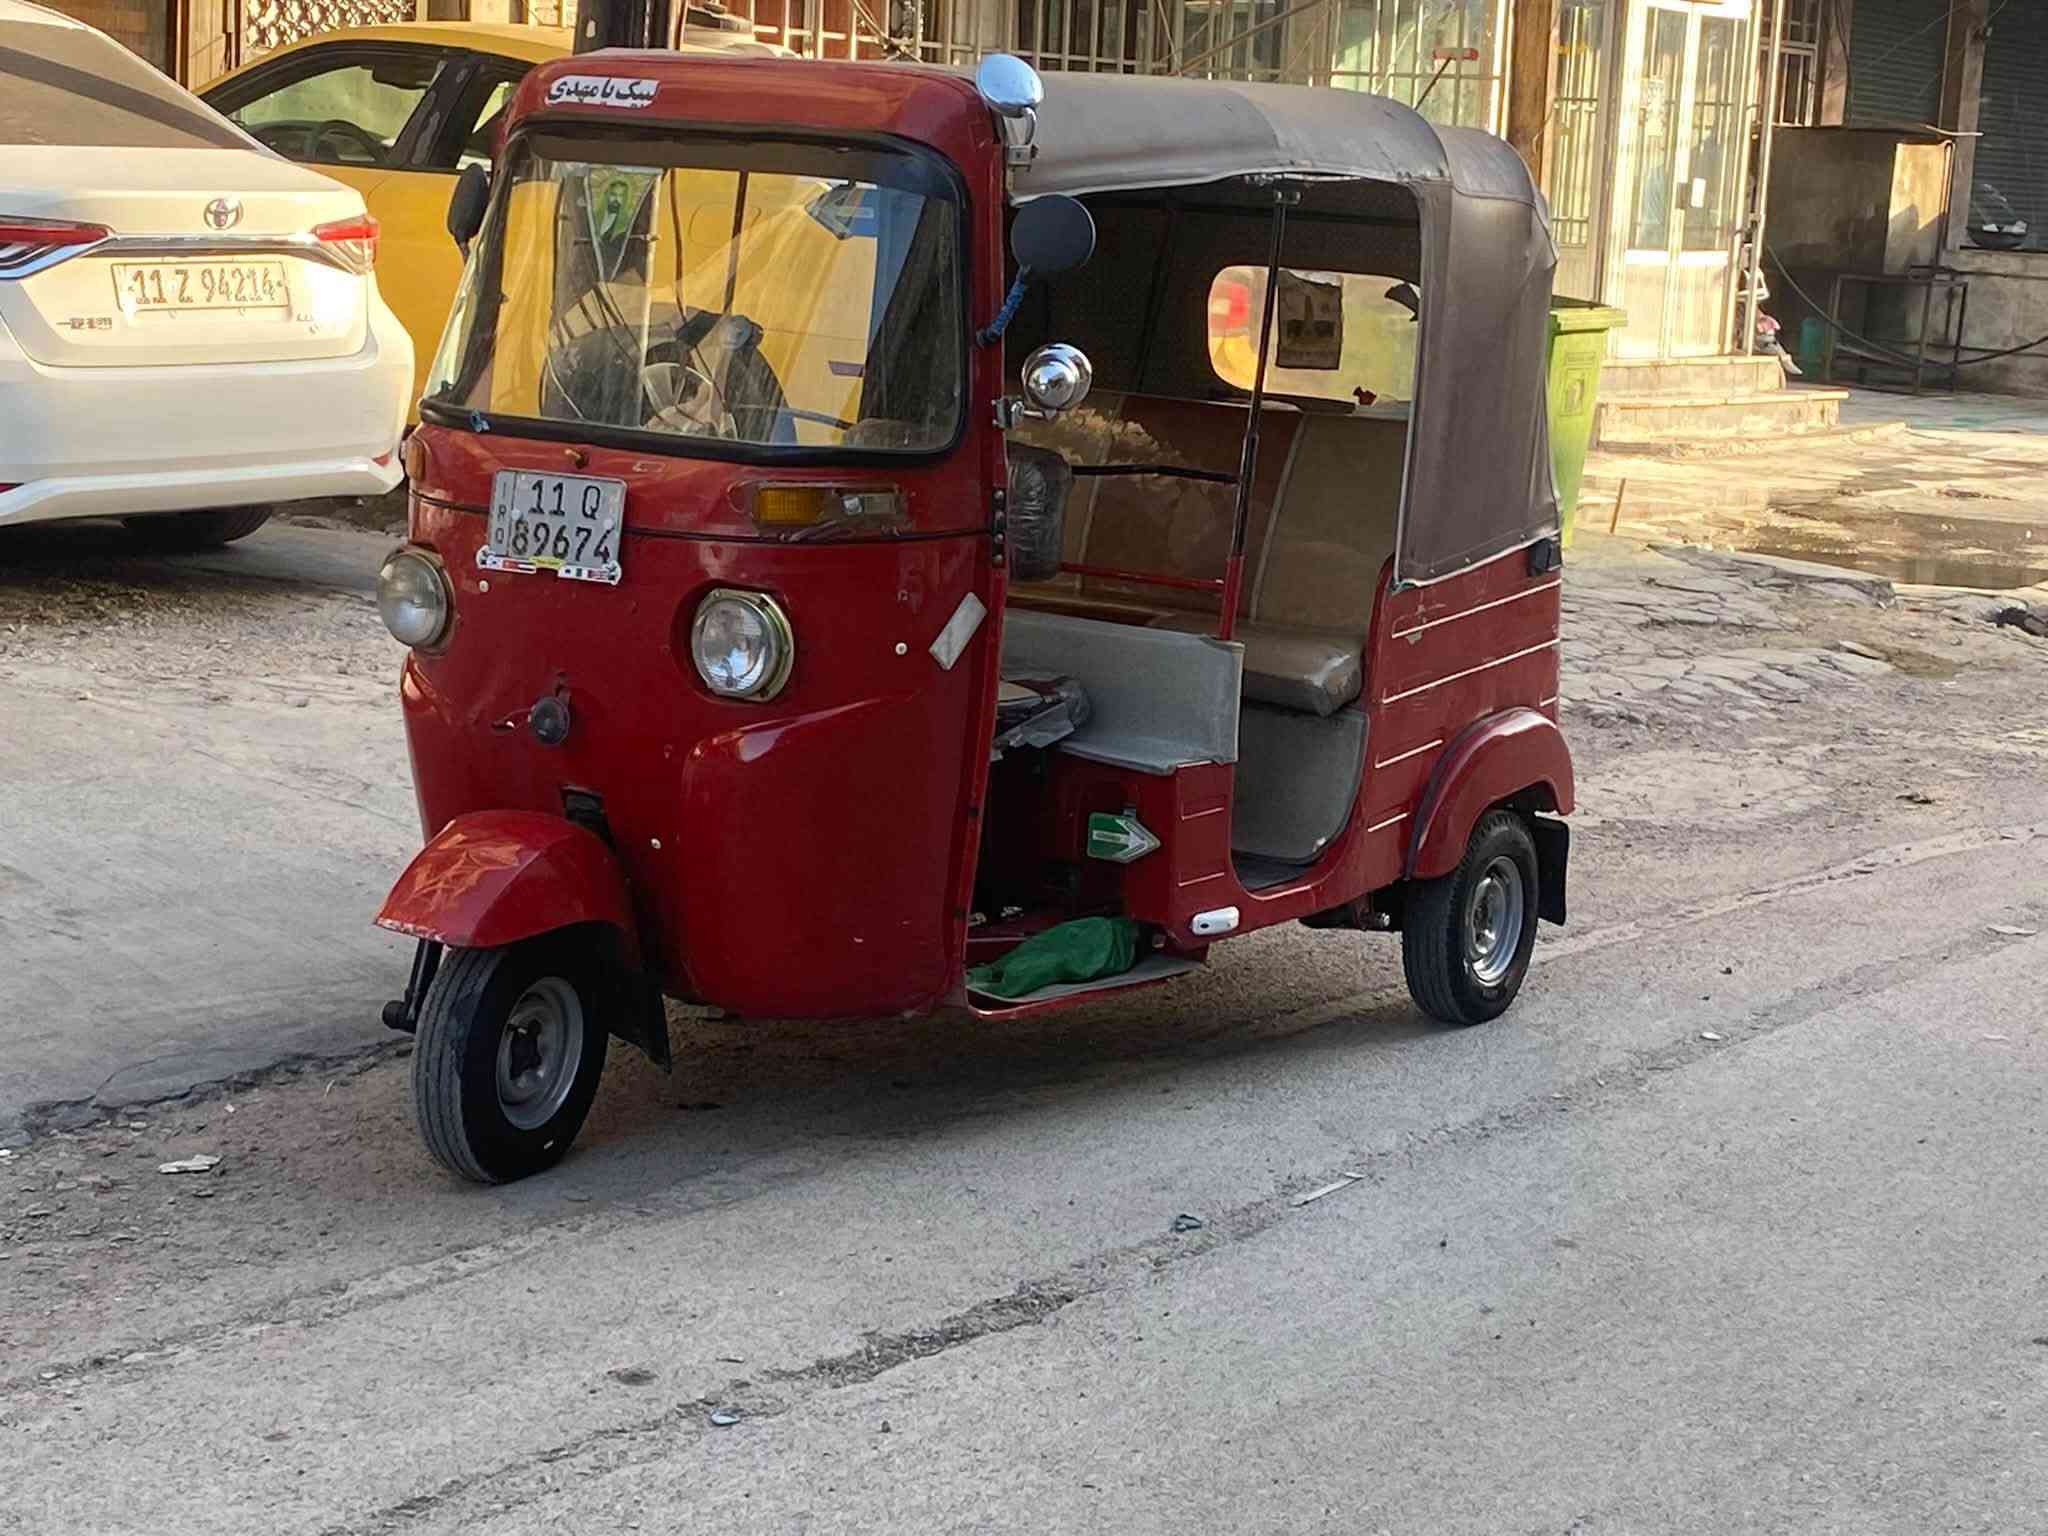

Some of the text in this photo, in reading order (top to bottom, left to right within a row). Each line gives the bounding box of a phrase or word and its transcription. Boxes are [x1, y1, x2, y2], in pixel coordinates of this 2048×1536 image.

[133, 267, 276, 304] 11 Z 94214
[495, 482, 507, 544] IRQ
[528, 479, 601, 520] 11 Q
[511, 515, 615, 563] 89674
